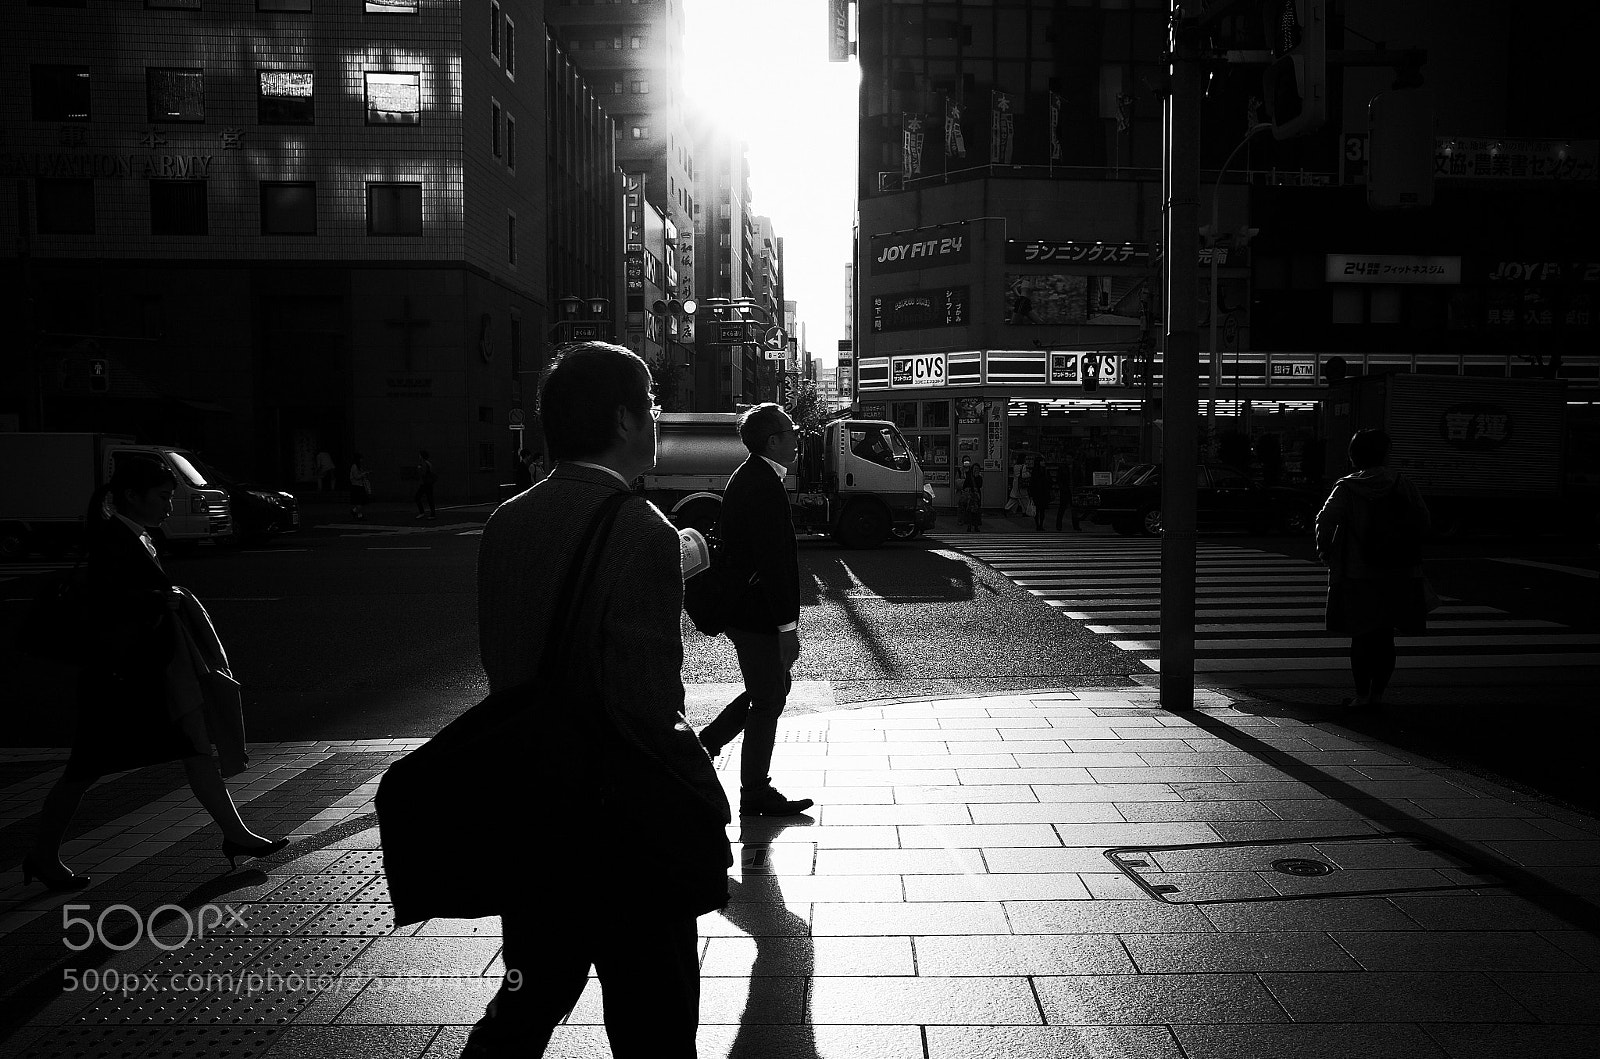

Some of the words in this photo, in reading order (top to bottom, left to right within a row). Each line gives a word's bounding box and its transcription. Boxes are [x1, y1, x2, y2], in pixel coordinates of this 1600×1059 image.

[143, 155, 213, 179] ARMY
[940, 236, 963, 254] 24
[915, 356, 944, 378] CVS
[1294, 365, 1313, 375] ATM
